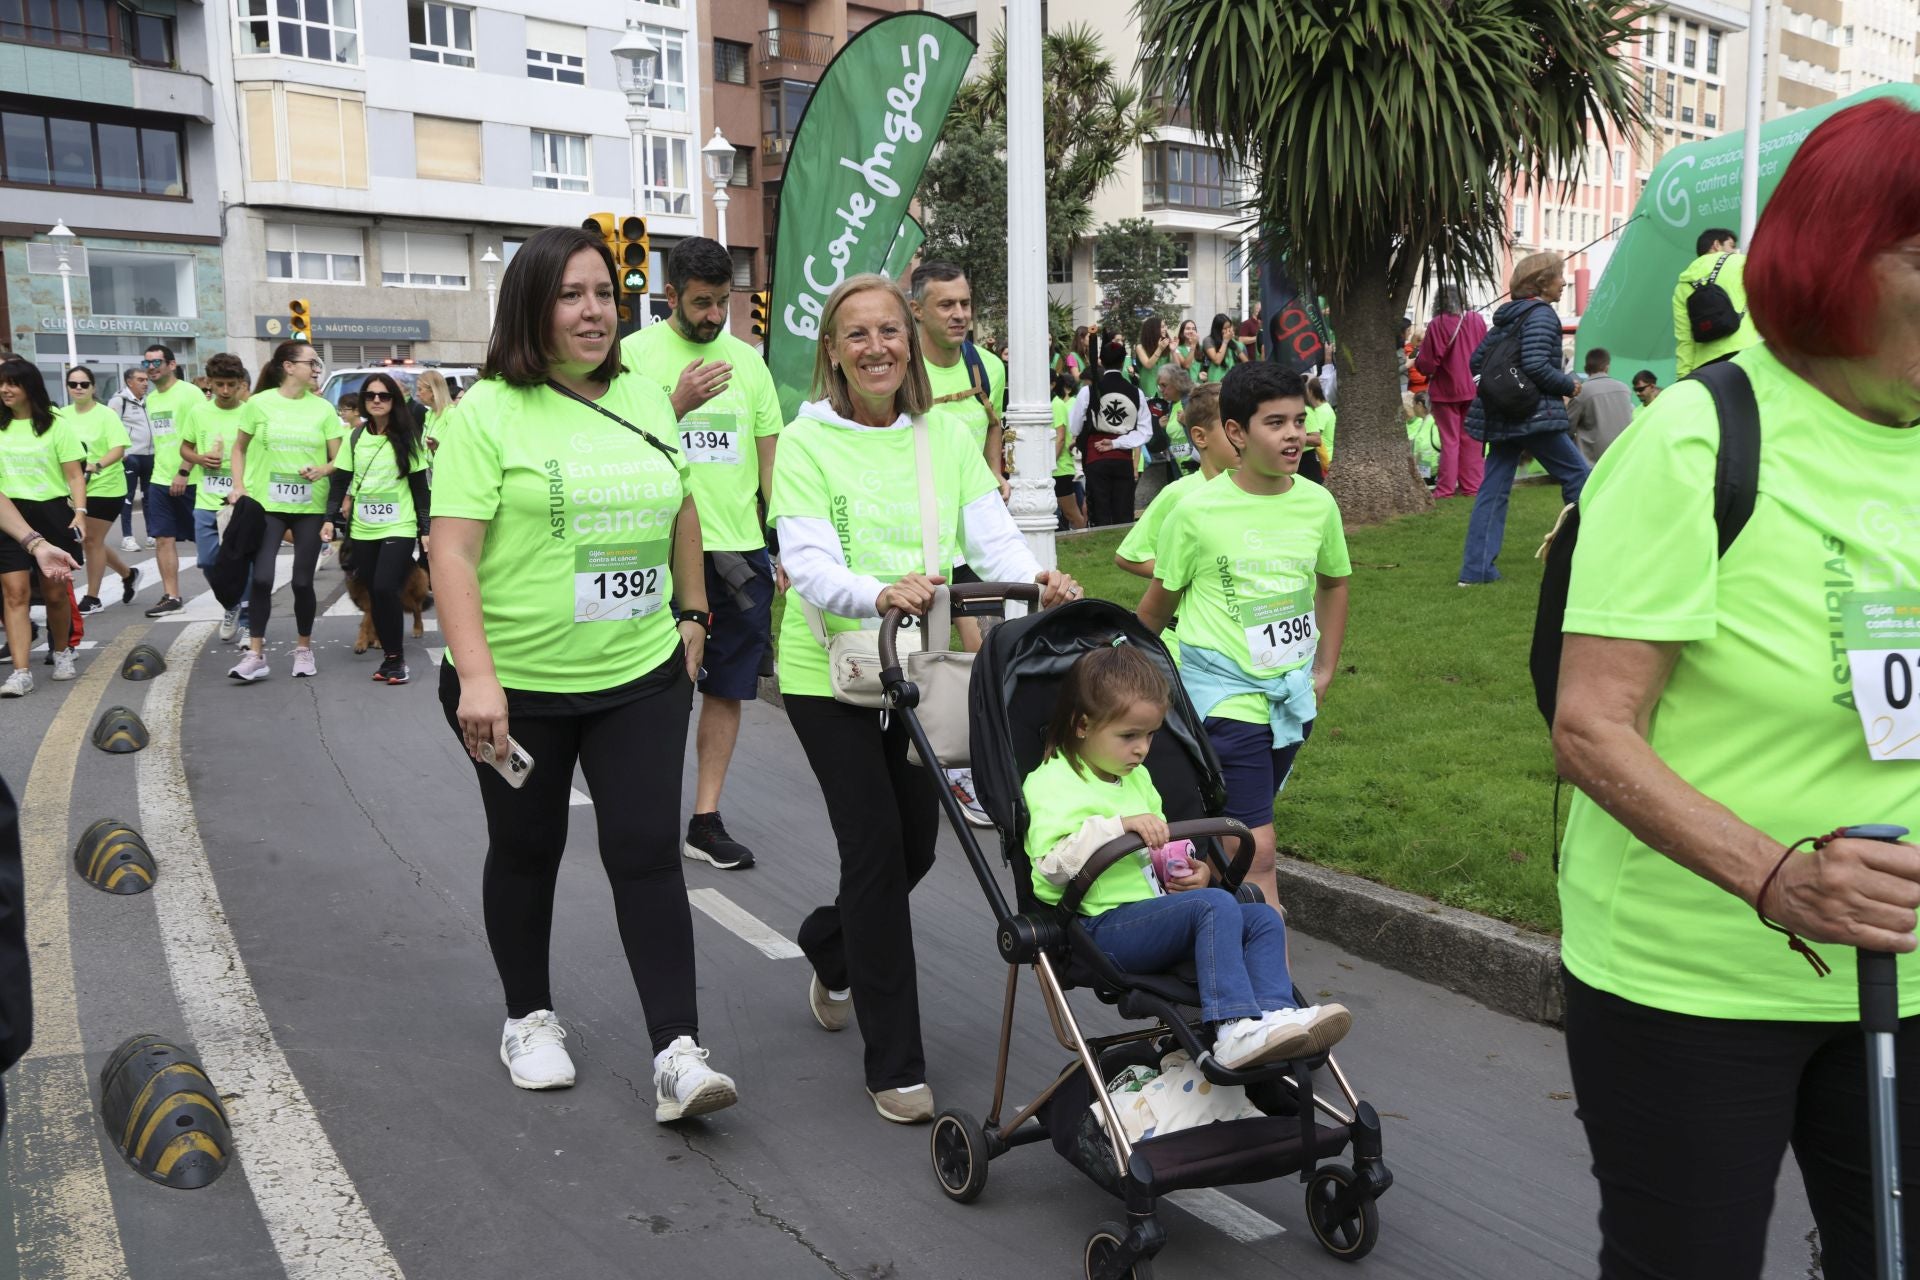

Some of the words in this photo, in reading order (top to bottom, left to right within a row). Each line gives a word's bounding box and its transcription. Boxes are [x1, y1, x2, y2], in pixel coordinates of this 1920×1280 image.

[784, 293, 821, 342] El
[803, 191, 876, 295] Corte
[840, 33, 940, 198] Inglés
[1696, 174, 1727, 193] contra
[1729, 166, 1740, 185] el
[1699, 203, 1712, 216] en
[1712, 192, 1743, 213] Asturi
[100, 319, 148, 331] DENTAL
[153, 321, 190, 332] MAYO
[326, 323, 364, 333] NÁUTICO
[366, 326, 420, 334] FISIOTERAPIA
[682, 431, 729, 449] 1394
[566, 461, 595, 478] En
[207, 477, 233, 487] 1740
[276, 484, 306, 495] 1701
[544, 459, 566, 540] ASTURIAS
[572, 480, 658, 505] contra
[363, 503, 393, 515] 1326
[856, 523, 922, 545] contr
[1236, 559, 1259, 575] En
[594, 568, 657, 599] 1392
[1217, 555, 1241, 623] ASTURIAS
[1862, 604, 1894, 617] Gijón
[1263, 614, 1311, 647] 1396
[1866, 618, 1903, 629] contra
